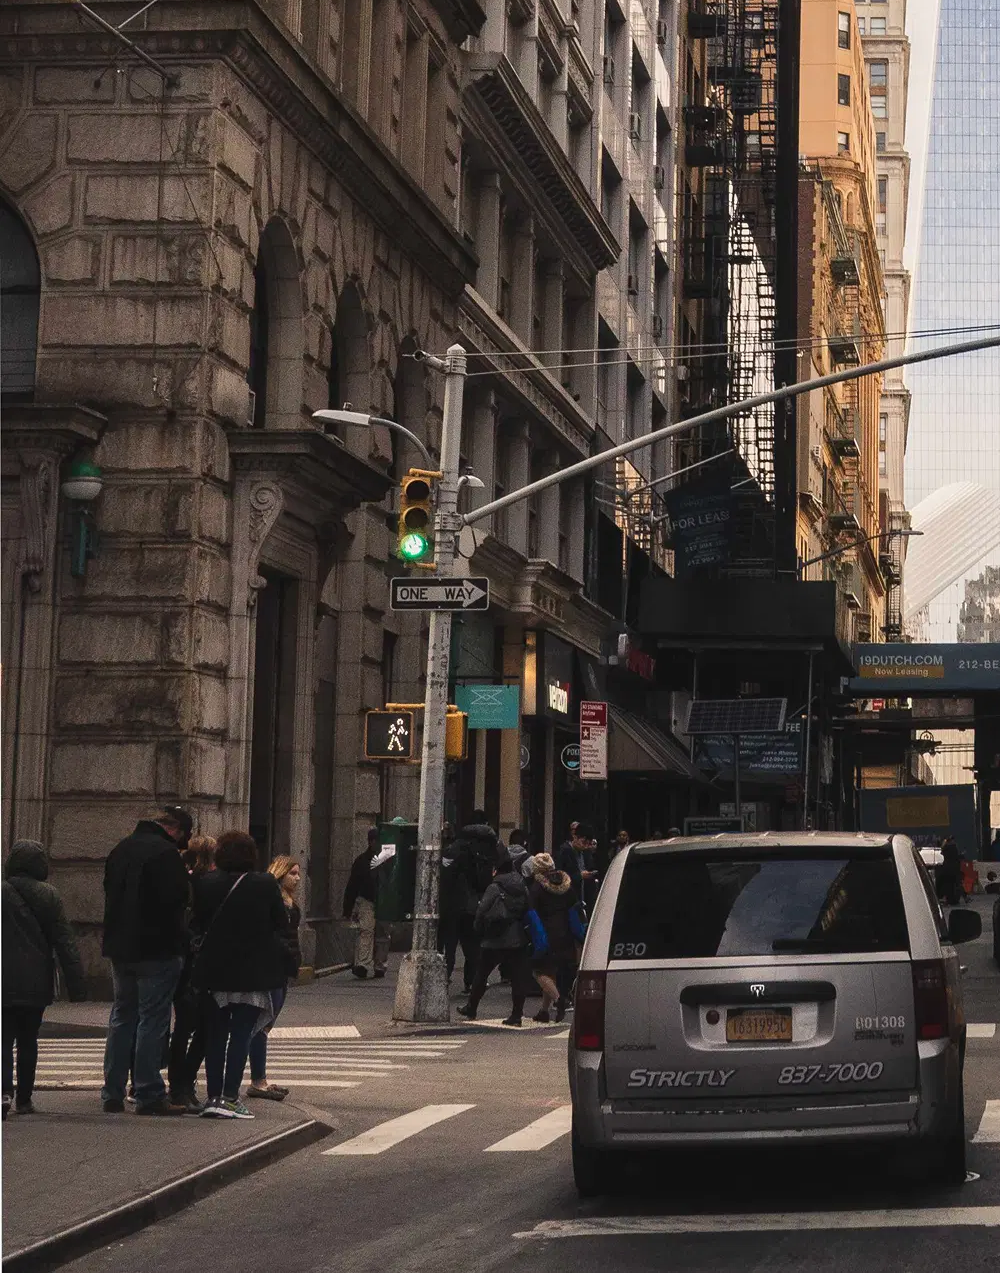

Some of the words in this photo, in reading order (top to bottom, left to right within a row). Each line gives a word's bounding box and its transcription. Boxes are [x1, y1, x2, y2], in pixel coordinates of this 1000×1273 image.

[698, 510, 731, 525] LEAS
[400, 588, 428, 600] ONE
[444, 588, 475, 600] WAY
[859, 655, 943, 666] 19DUTCH.COM
[895, 667, 929, 677] Leasing
[785, 722, 801, 732] FEE
[566, 748, 580, 756] POK
[613, 942, 647, 956] 830
[627, 1068, 736, 1087] STRICTLY
[778, 1061, 884, 1084] 837-7000
